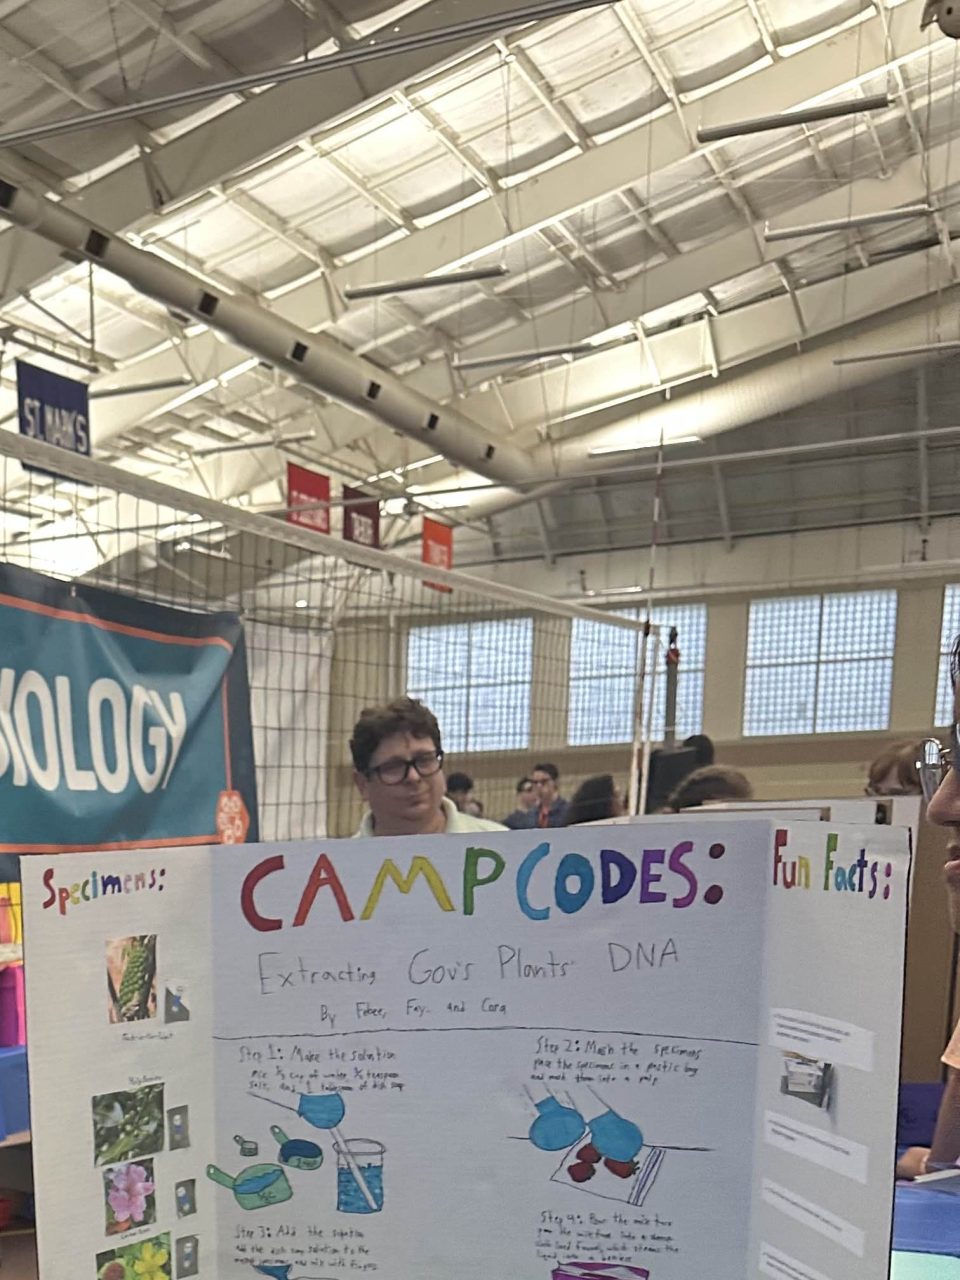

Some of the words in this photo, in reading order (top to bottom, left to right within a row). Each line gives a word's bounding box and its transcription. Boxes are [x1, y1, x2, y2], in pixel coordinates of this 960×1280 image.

[773, 828, 811, 889] Fun
[823, 832, 893, 900] Facts:
[42, 868, 166, 915] Specimens:
[258, 951, 376, 995] Extracting
[408, 948, 475, 985] Gov's
[608, 937, 679, 973] DNA
[321, 1004, 336, 1029] By
[240, 1045, 262, 1063] Step
[268, 1044, 283, 1060] 1:
[329, 1048, 345, 1061] the
[536, 1036, 559, 1054] Step
[564, 1040, 580, 1052] 2:
[621, 1042, 638, 1055] the
[557, 1058, 572, 1069] the
[541, 1211, 563, 1228] Step
[613, 1211, 628, 1226] the
[234, 1224, 254, 1239] Step
[257, 1226, 271, 1238] 3:
[276, 1225, 296, 1237] Add
[307, 1225, 323, 1238] the
